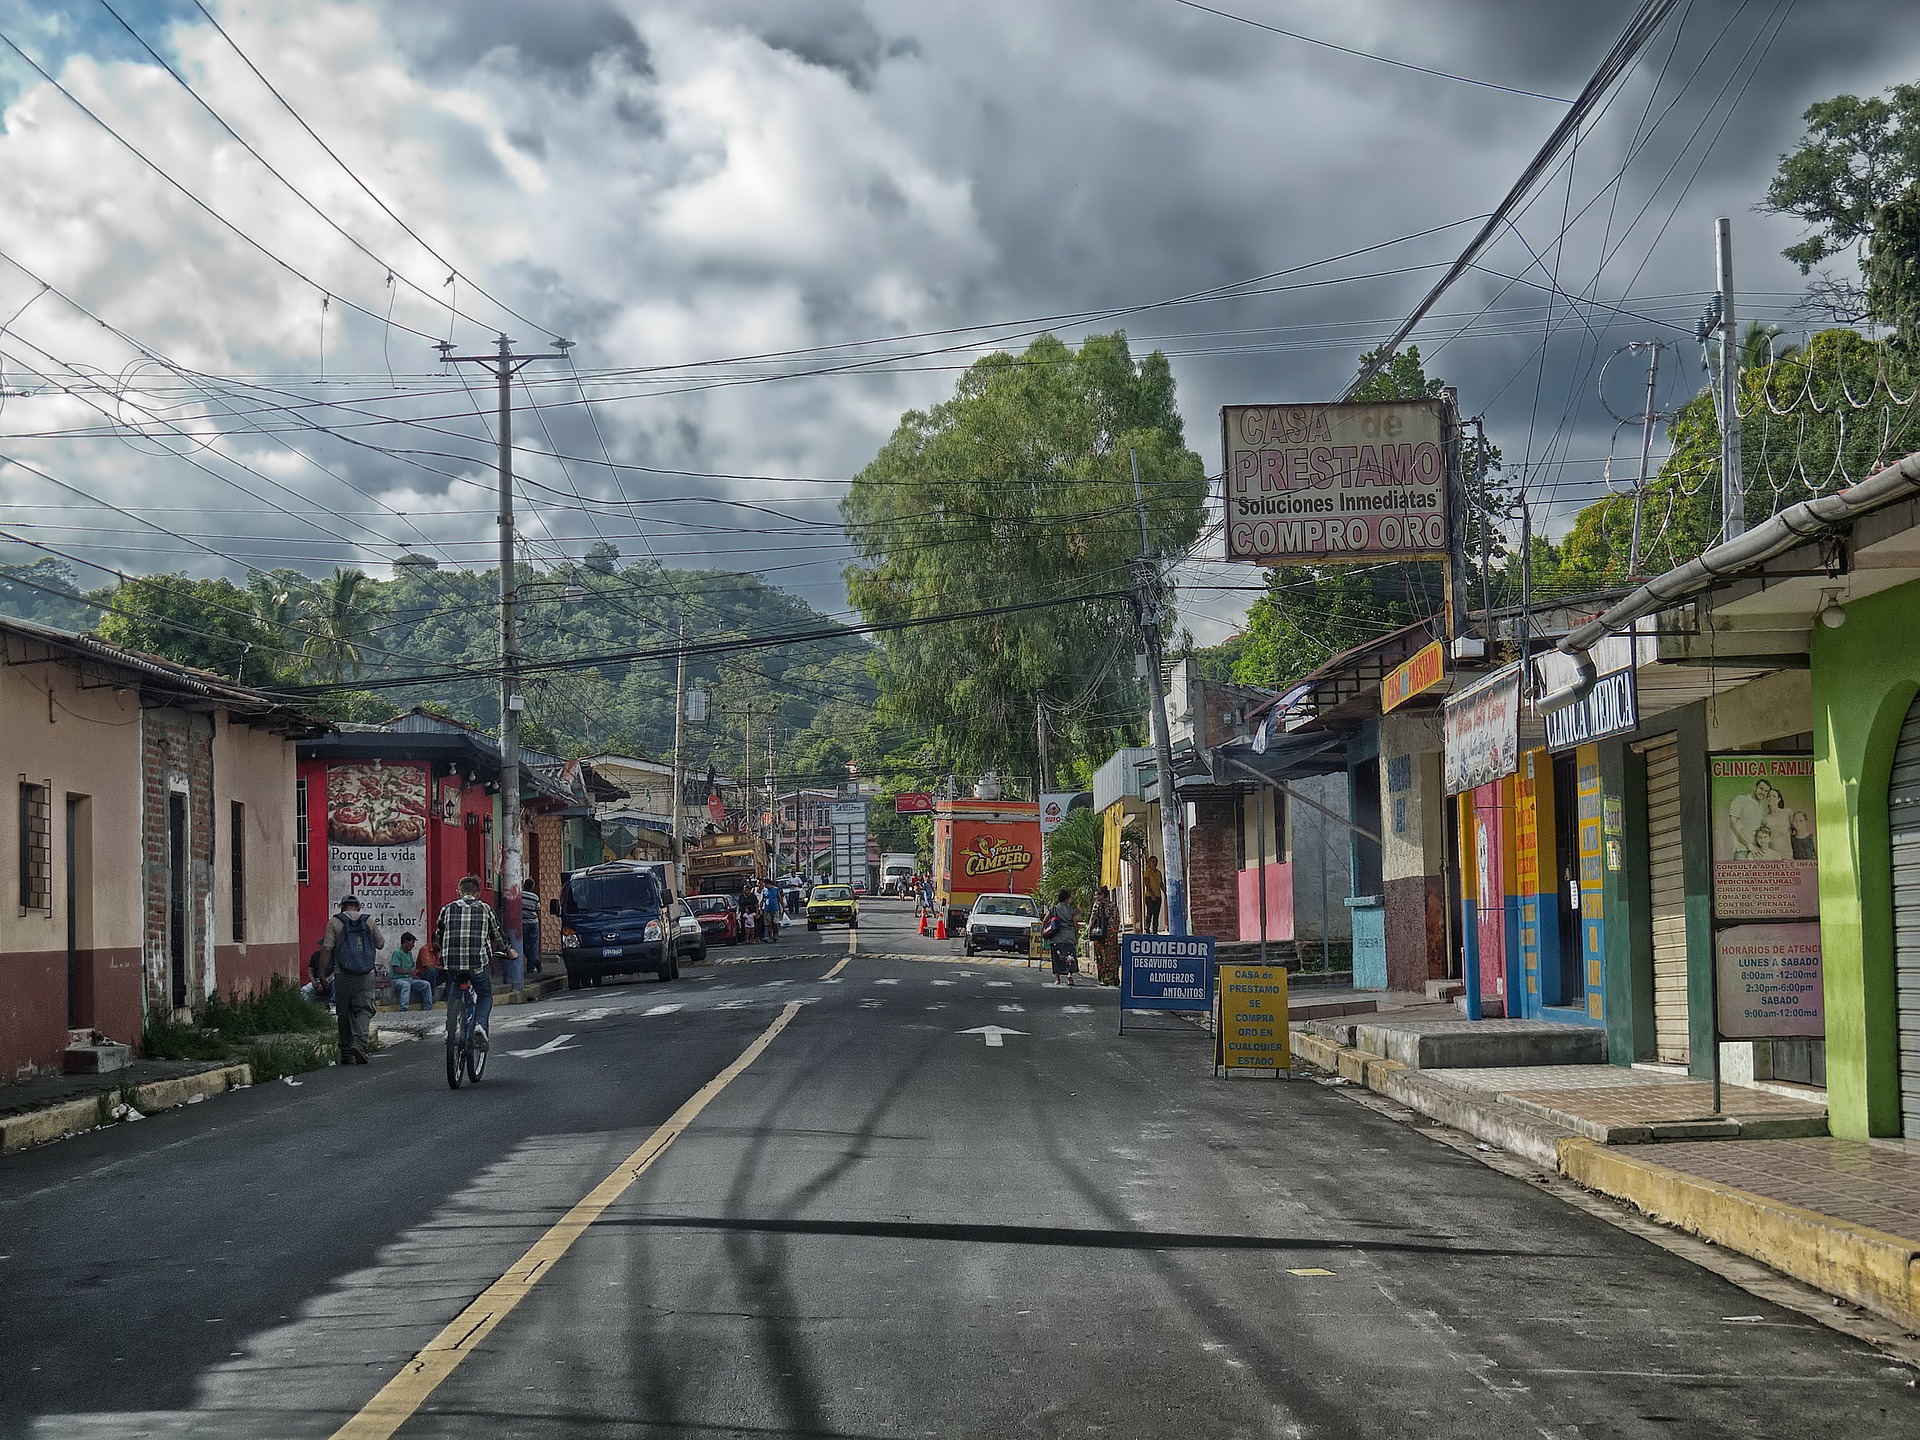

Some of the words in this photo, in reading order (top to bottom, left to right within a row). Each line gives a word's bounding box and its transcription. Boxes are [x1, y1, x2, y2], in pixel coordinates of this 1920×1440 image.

[1240, 406, 1332, 446] CASA
[1235, 442, 1442, 493] PRESTAMO
[1231, 517, 1370, 556] COMPRO
[1378, 514, 1445, 550] ORO
[1545, 700, 1588, 748] CLINICA
[1588, 671, 1635, 737] MEDICA
[1712, 760, 1768, 777] CLINICA
[331, 847, 374, 864] Porque
[377, 847, 388, 860] la
[391, 847, 416, 861] vida
[995, 844, 1024, 856] POLLO
[332, 864, 341, 872] es
[343, 864, 367, 872] como
[369, 864, 385, 872] una
[965, 851, 1032, 876] CAMPERO
[351, 872, 402, 895] pizza
[357, 888, 383, 896] nunca
[384, 884, 414, 901] puedes
[374, 913, 385, 926] el
[1130, 940, 1208, 956] COMEDOR
[1721, 945, 1770, 955] HORARIOS
[1772, 945, 1785, 954] DE
[1134, 957, 1178, 969] DESAYUNOS
[1738, 958, 1769, 968] LUNES
[1771, 958, 1778, 967] A
[1780, 957, 1819, 967] SABADO
[1149, 972, 1195, 983] ALMUERZOS
[1234, 970, 1260, 979] CASA
[1261, 971, 1273, 979] de
[1741, 971, 1774, 980] 8:00am
[1162, 987, 1204, 998] ANTOJITOS
[1229, 984, 1279, 994] PRESTAMO
[1745, 983, 1814, 994] 2:30pm-6:00pm
[1248, 999, 1261, 1008] SE
[1761, 996, 1799, 1005] SABADO
[1235, 1013, 1274, 1023] COMPRA
[1744, 1008, 1818, 1018] 9:00am-12:00md
[1237, 1028, 1258, 1037] ORO
[1260, 1028, 1273, 1037] EN
[1228, 1042, 1283, 1052] CUALQUIER
[1237, 1056, 1275, 1066] ESTADO
